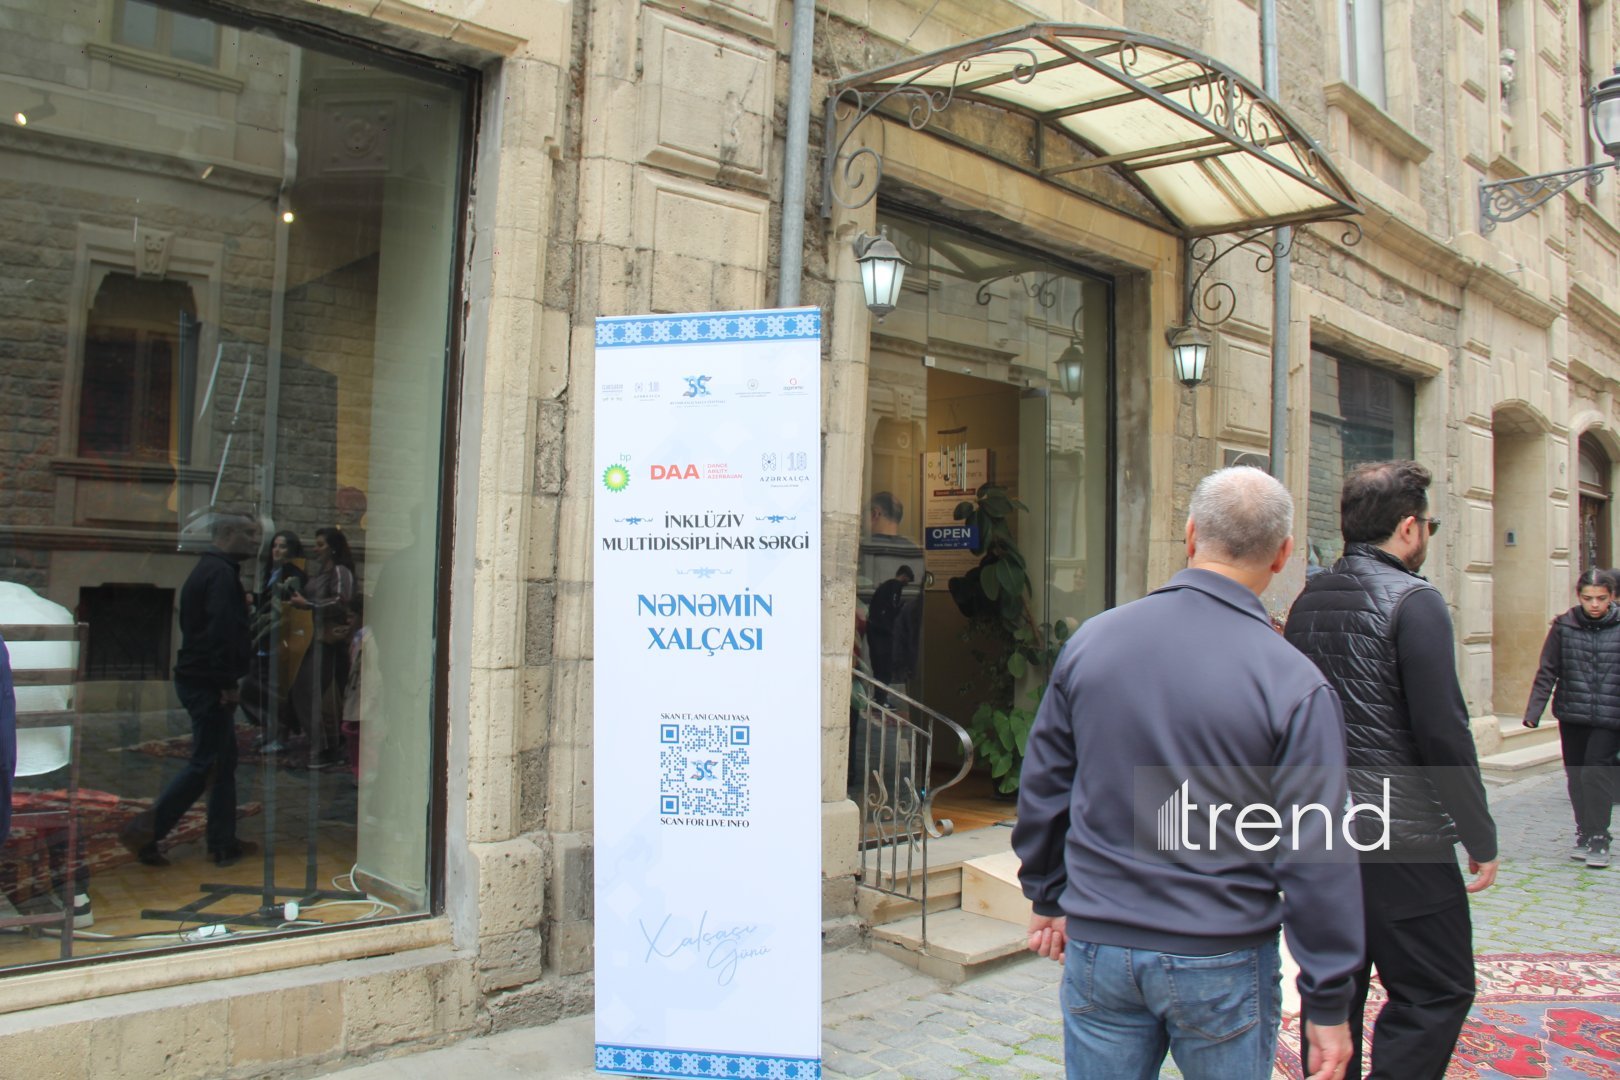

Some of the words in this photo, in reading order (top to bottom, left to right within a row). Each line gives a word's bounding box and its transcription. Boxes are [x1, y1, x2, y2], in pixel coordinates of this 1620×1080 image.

[620, 453, 631, 463] bp
[650, 464, 700, 480] DAA
[664, 511, 744, 529] İNKLÜZİV
[602, 532, 755, 551] MULTİDİSSİPLİNAR
[758, 531, 810, 550] SƏRGİ
[932, 527, 971, 539] OPEN
[637, 587, 773, 617] NƏNƏMİN
[647, 627, 763, 657] XALÇASI
[660, 817, 684, 826] SCAN
[686, 818, 704, 826] FOR
[706, 818, 726, 828] LIVE
[727, 819, 750, 828] INFO
